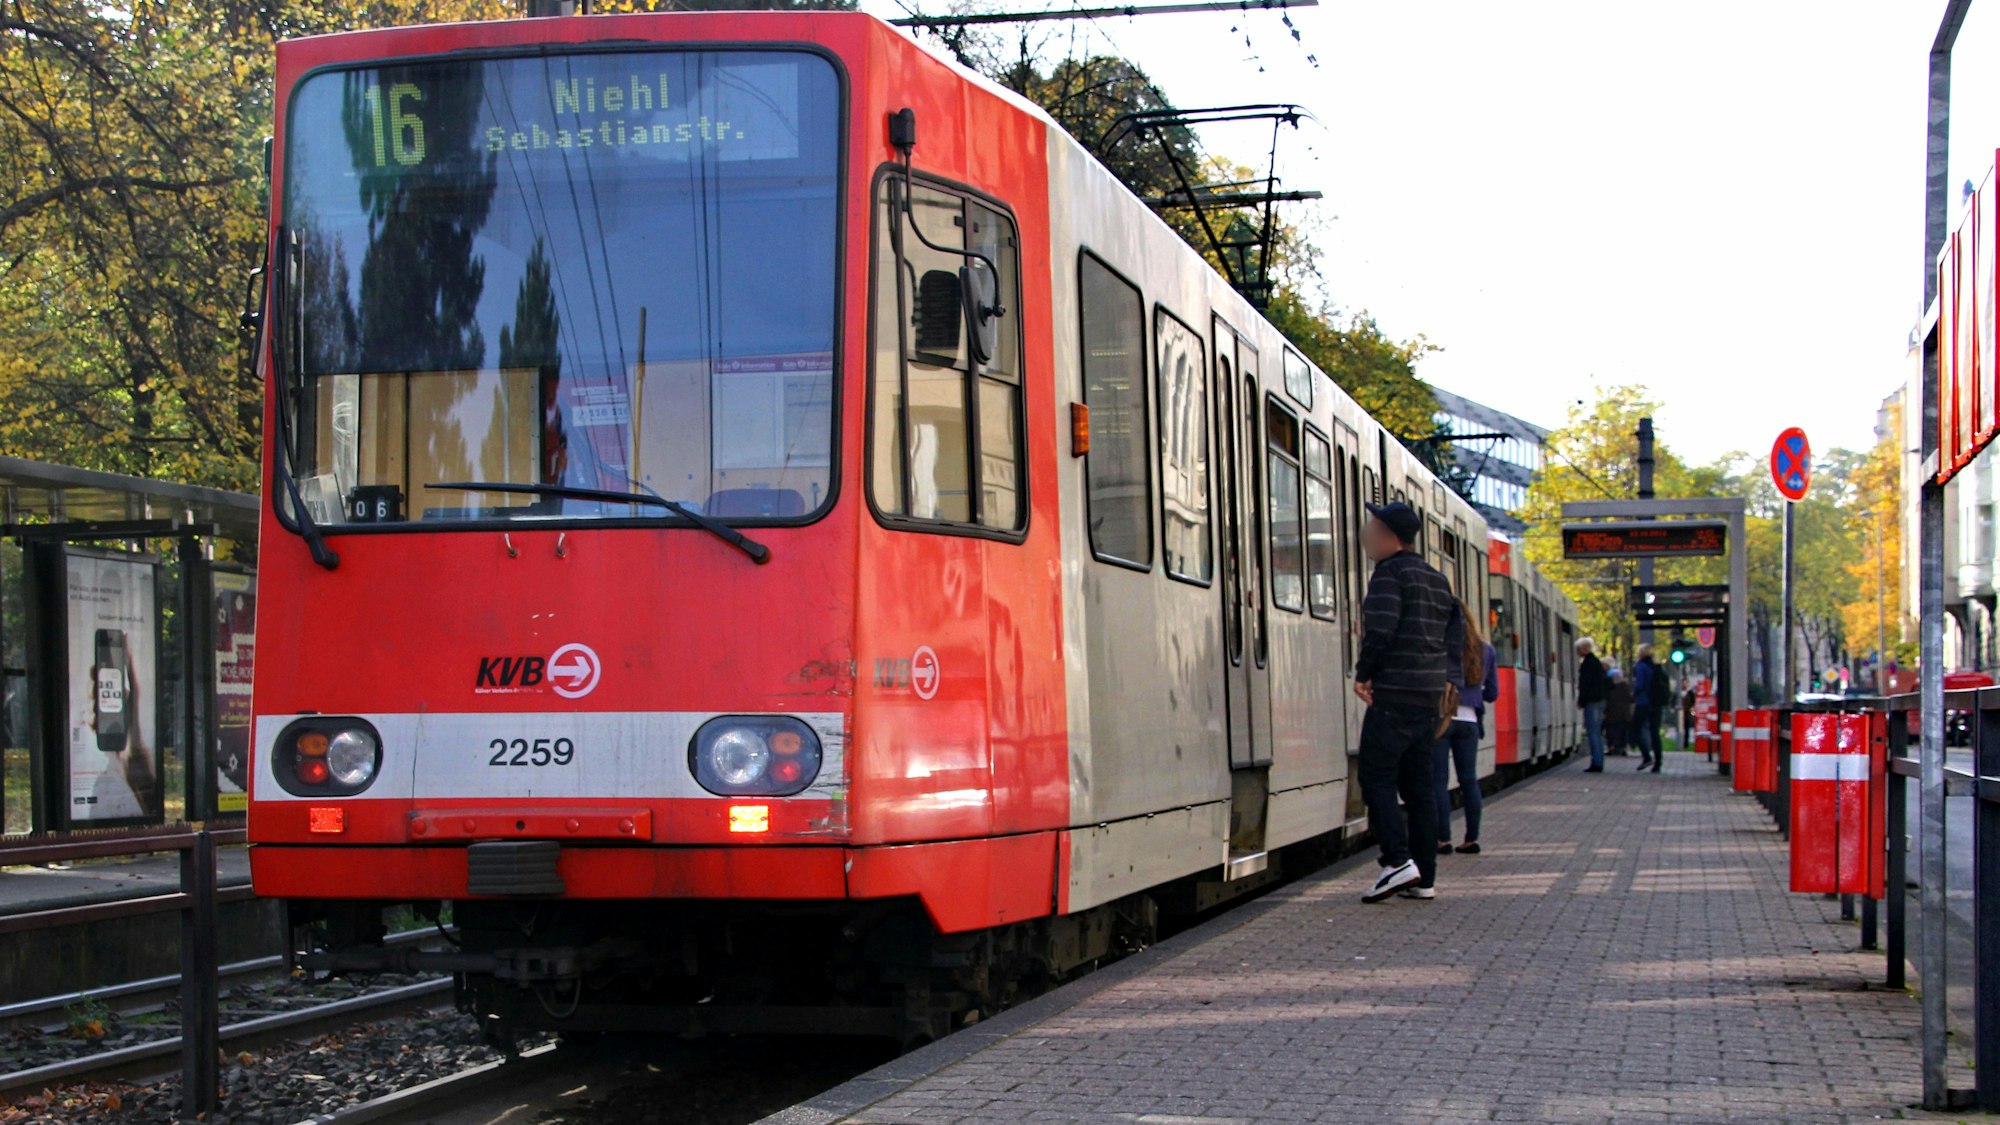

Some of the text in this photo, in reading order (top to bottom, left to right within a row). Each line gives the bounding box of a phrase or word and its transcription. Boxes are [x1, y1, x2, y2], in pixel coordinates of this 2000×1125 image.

[555, 73, 669, 114] Niehl
[365, 83, 425, 166] 16
[485, 116, 745, 152] Sebastianstr.
[476, 656, 545, 687] KVB
[873, 656, 911, 688] KVB
[489, 737, 574, 767] 2259
